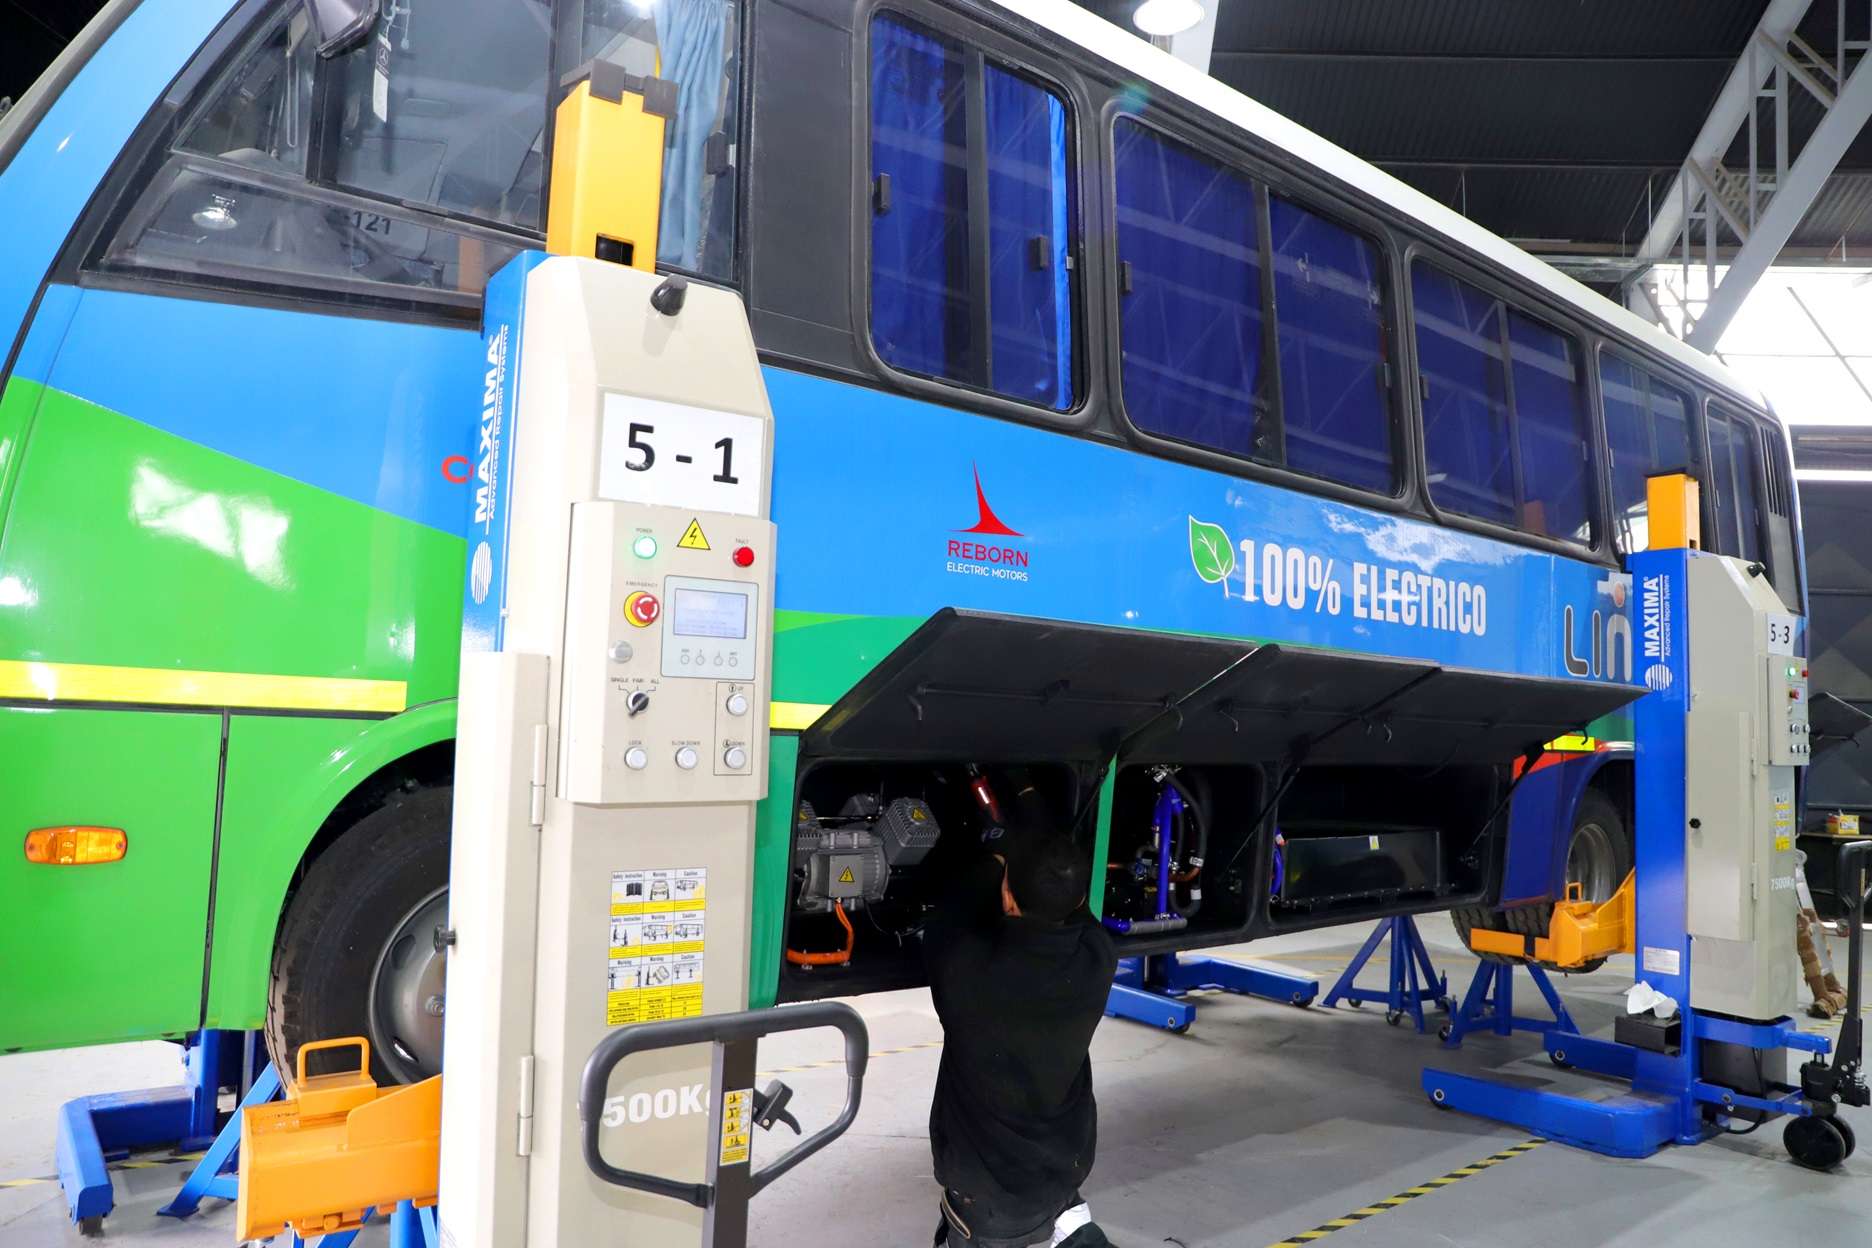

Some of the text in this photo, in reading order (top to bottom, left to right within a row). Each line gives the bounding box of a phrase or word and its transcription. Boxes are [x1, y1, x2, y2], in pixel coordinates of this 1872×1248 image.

[474, 332, 502, 524] MAXIMA
[489, 324, 509, 520] Advanced Repair Systems
[624, 422, 655, 472] 5
[713, 437, 739, 485] 1
[946, 562, 1029, 582] ELECTRIC MOTORS
[947, 540, 1028, 567] REBORN
[1240, 539, 1487, 637] 100% ELECTRICO
[1643, 576, 1660, 657] MAXIMA
[602, 1083, 711, 1128] 500K
